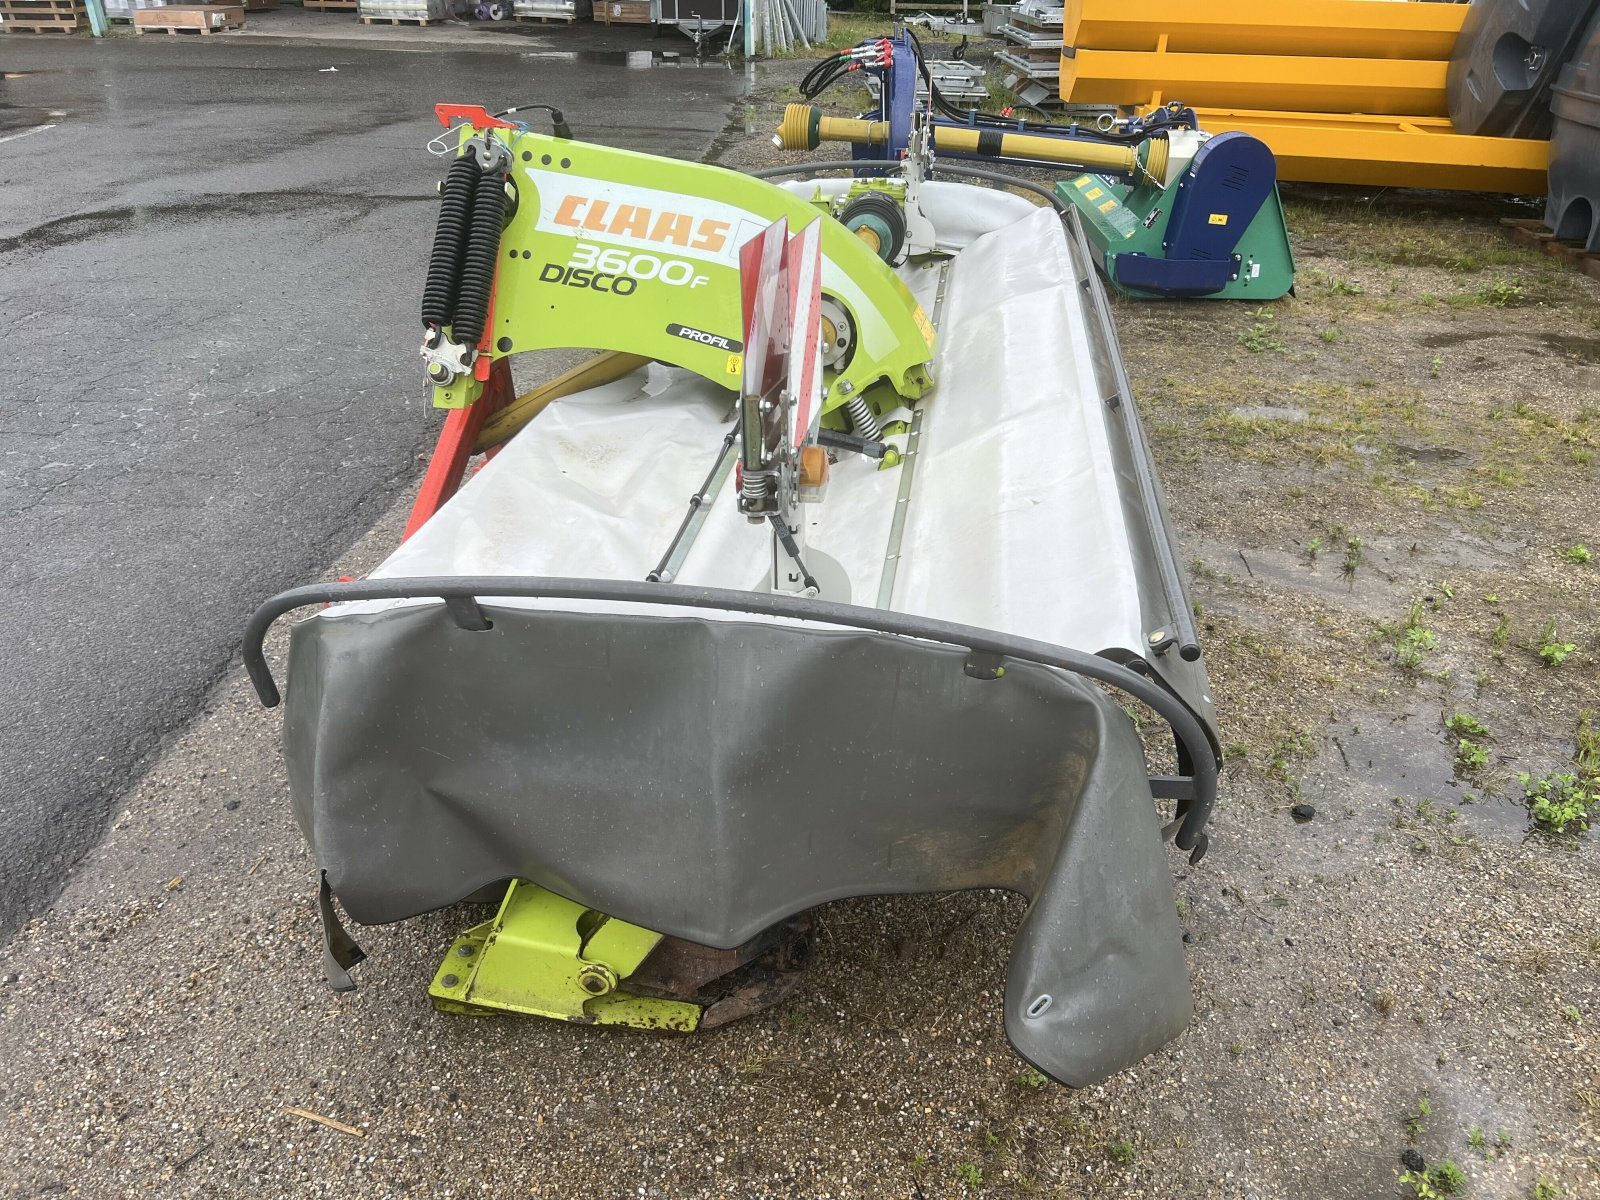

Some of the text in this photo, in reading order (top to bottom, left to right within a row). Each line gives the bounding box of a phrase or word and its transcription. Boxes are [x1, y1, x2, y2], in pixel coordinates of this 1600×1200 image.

[553, 195, 731, 252] CLAAS
[539, 263, 638, 296] DISCO
[678, 327, 730, 350] PROFIL
